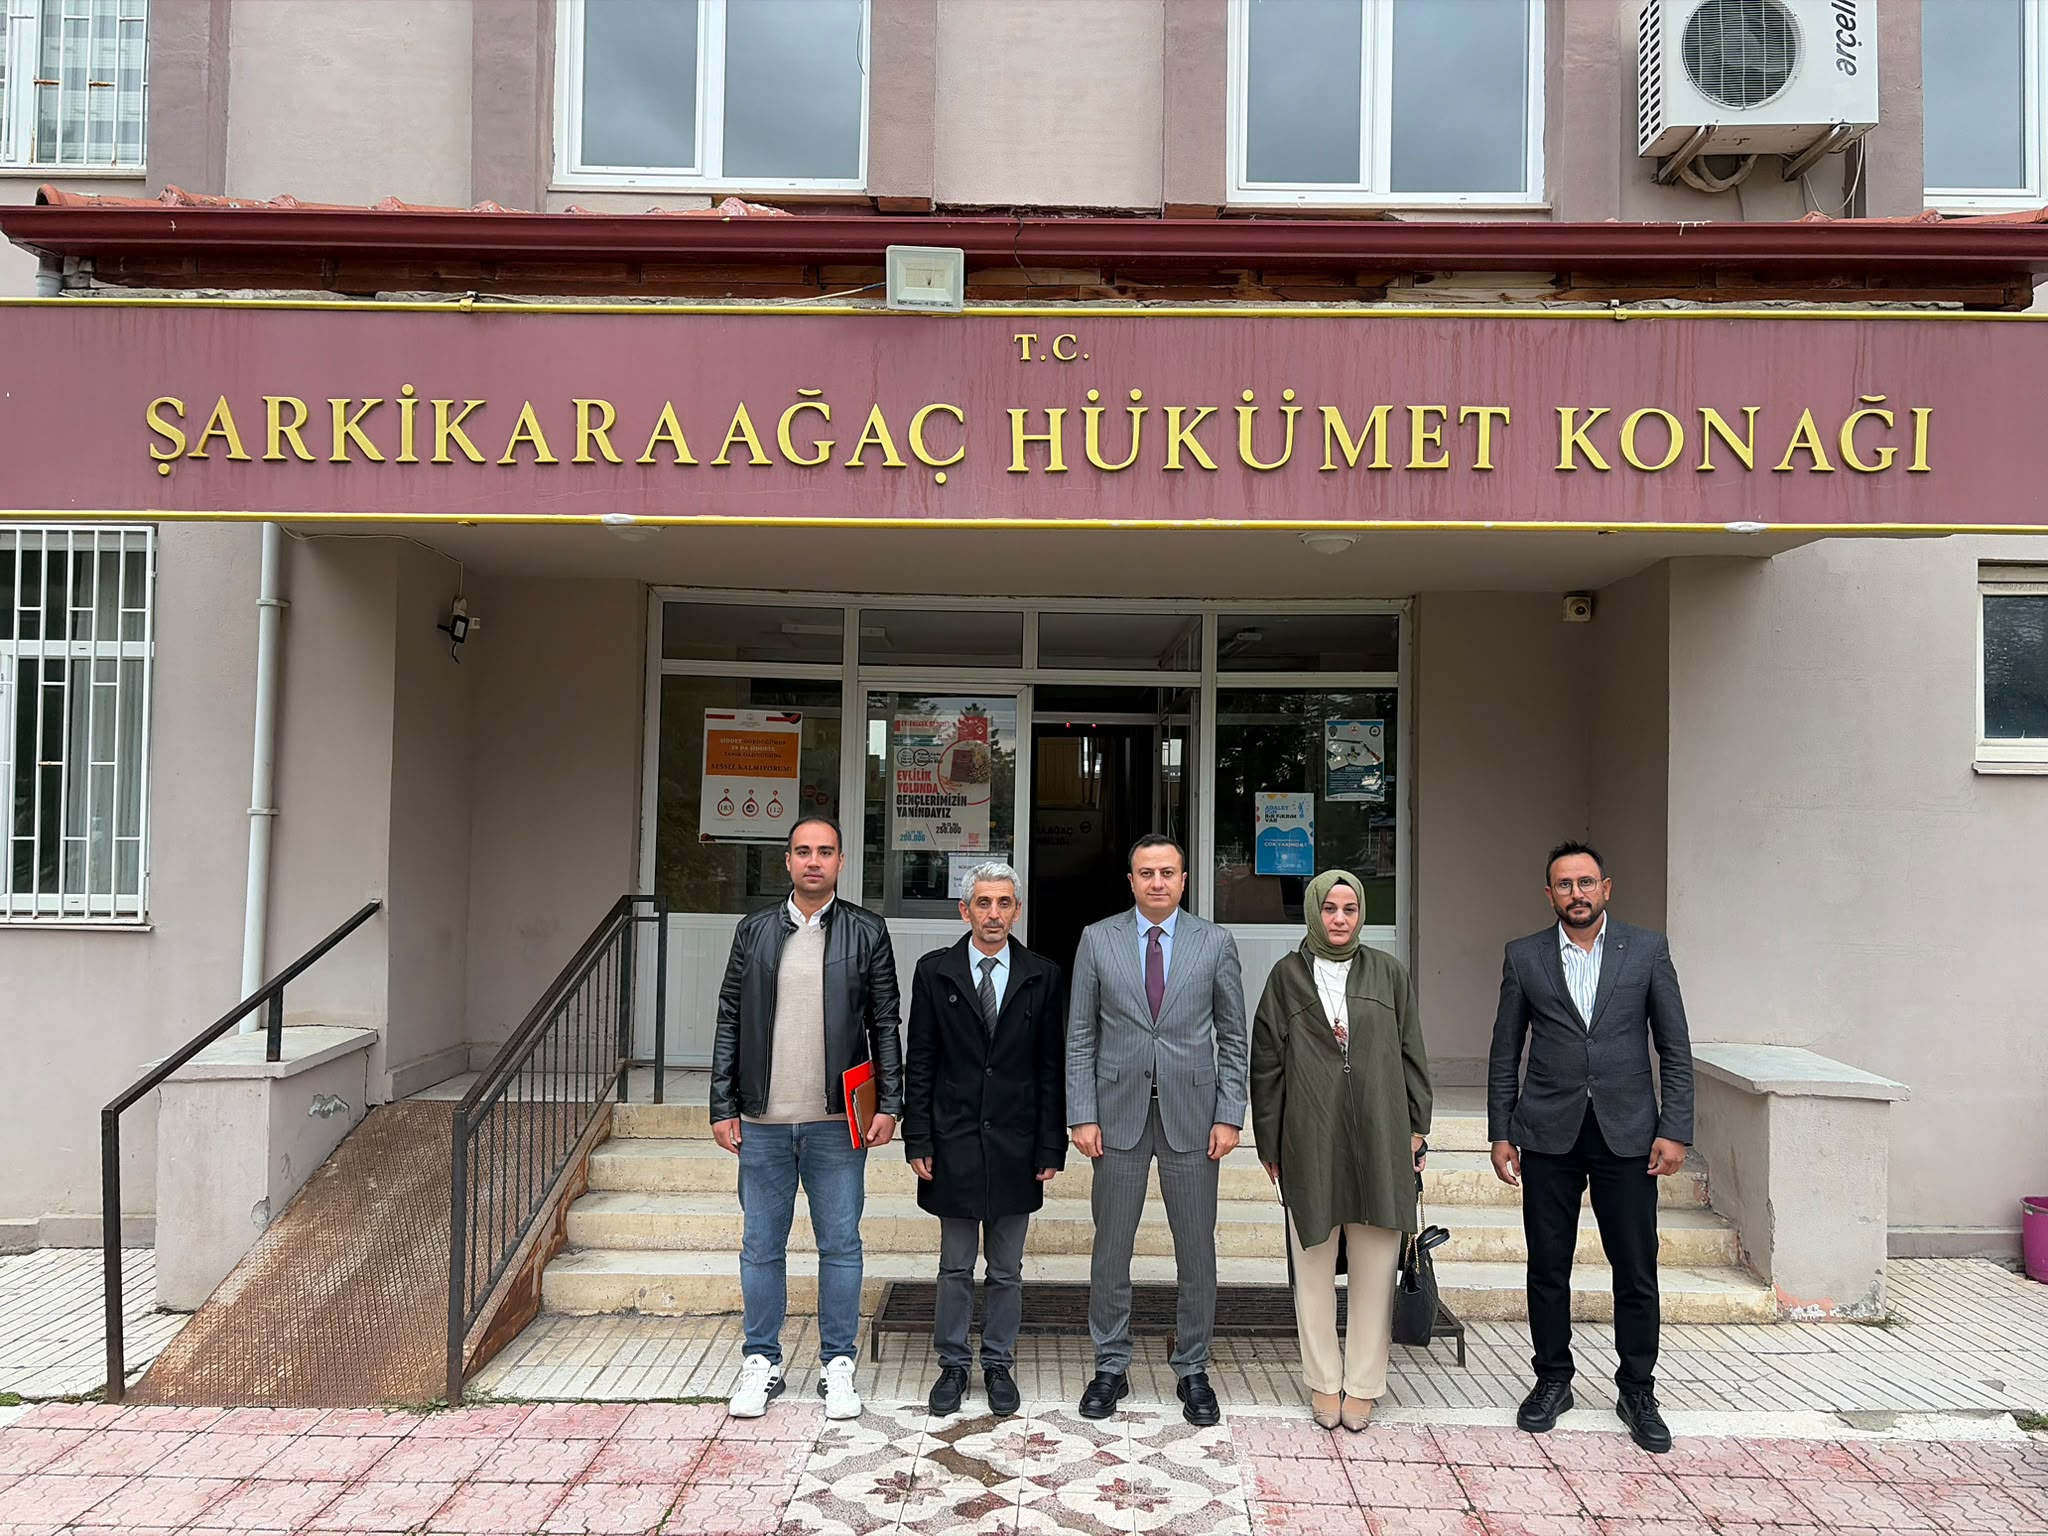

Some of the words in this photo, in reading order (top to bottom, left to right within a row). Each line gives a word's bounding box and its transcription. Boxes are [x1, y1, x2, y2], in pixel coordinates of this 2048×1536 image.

[1013, 333, 1090, 362] T.C.
[146, 383, 966, 484] ŞARKİKARAAĞAÇ
[1006, 388, 1511, 472] HÜKÜMET
[1555, 395, 1933, 472] KONAĞI
[896, 768, 932, 781] EVLİLİK
[896, 782, 938, 794] YOLUNDA
[896, 793, 967, 807] GENÇLERİMİZİN
